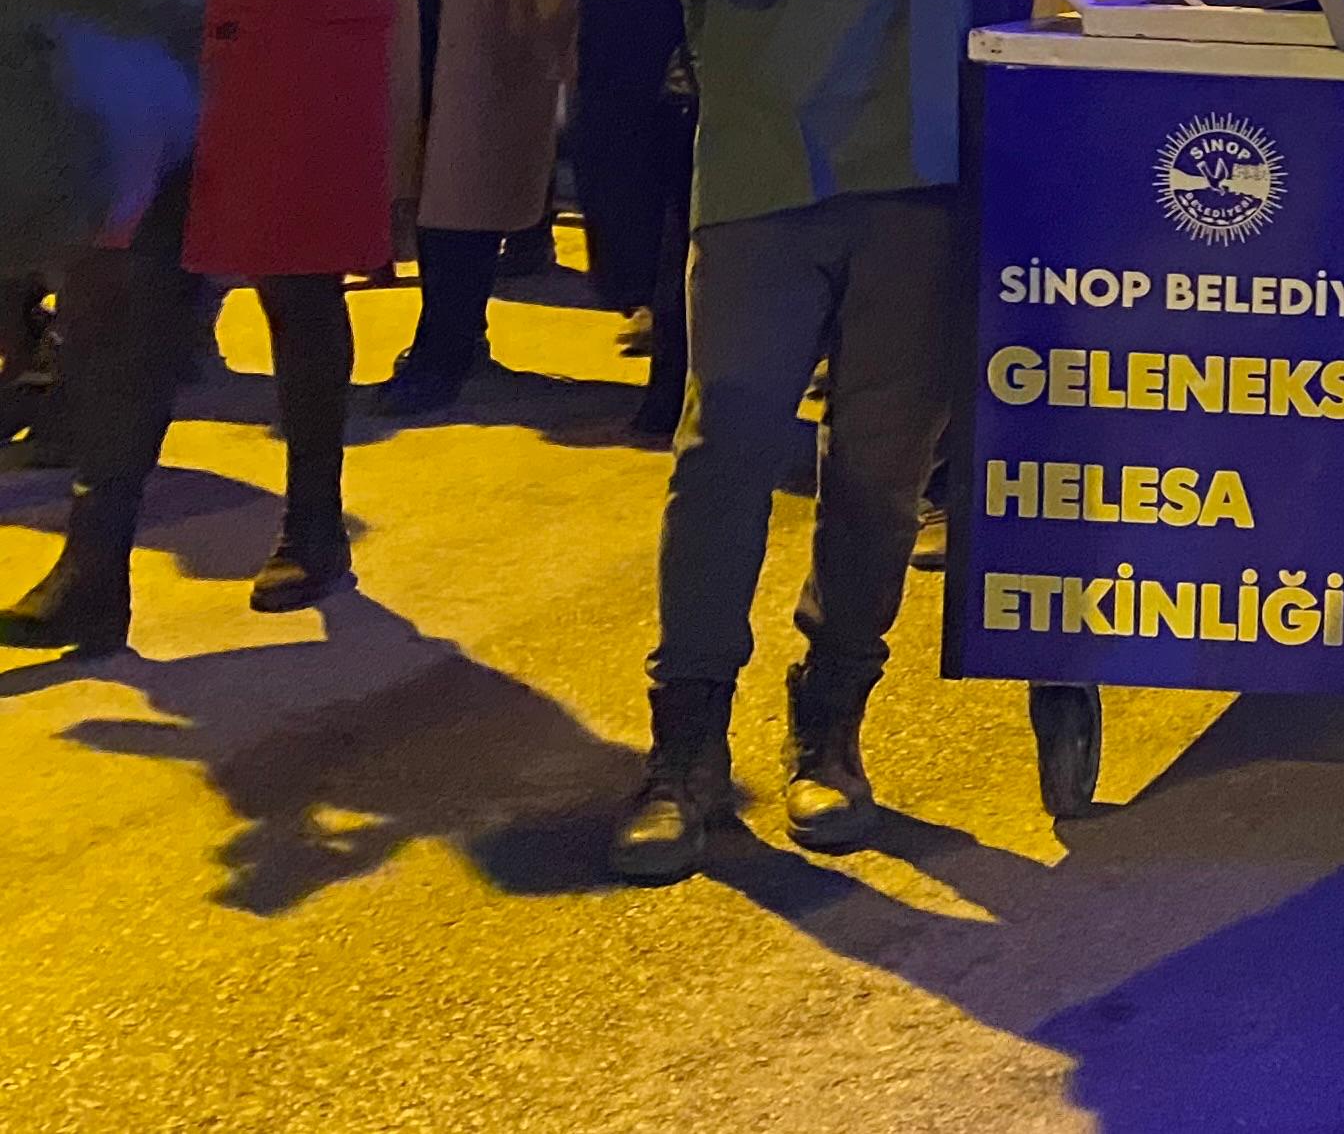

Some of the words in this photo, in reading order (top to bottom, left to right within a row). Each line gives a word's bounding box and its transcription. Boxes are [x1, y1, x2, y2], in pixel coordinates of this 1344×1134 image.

[1189, 138, 1252, 161] SİNOP
[999, 257, 1152, 308] SİNOP
[985, 459, 1255, 529] HELESA
[983, 562, 1344, 647] ETKİNLİĞİ
